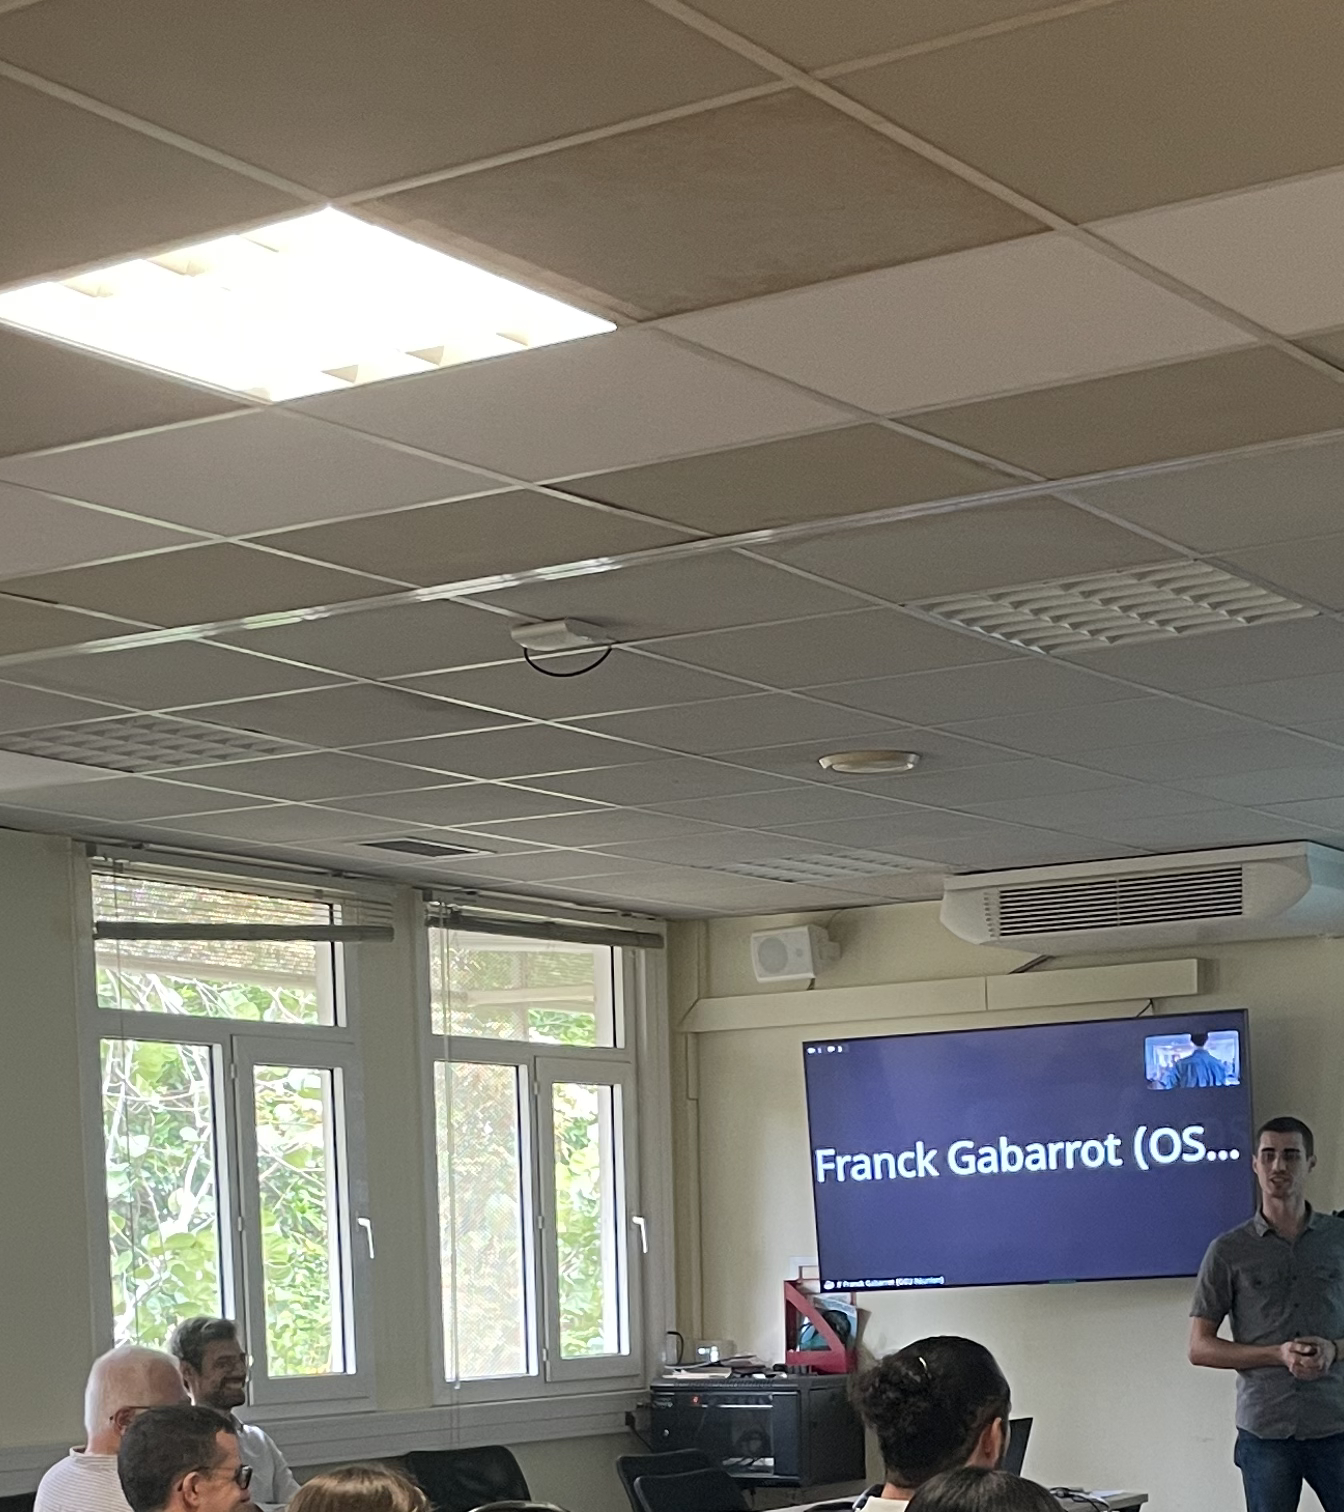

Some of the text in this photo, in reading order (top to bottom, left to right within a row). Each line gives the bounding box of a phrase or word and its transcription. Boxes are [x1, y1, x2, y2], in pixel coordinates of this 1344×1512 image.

[816, 1125, 1241, 1183] Franck Gabarrot (OS...
